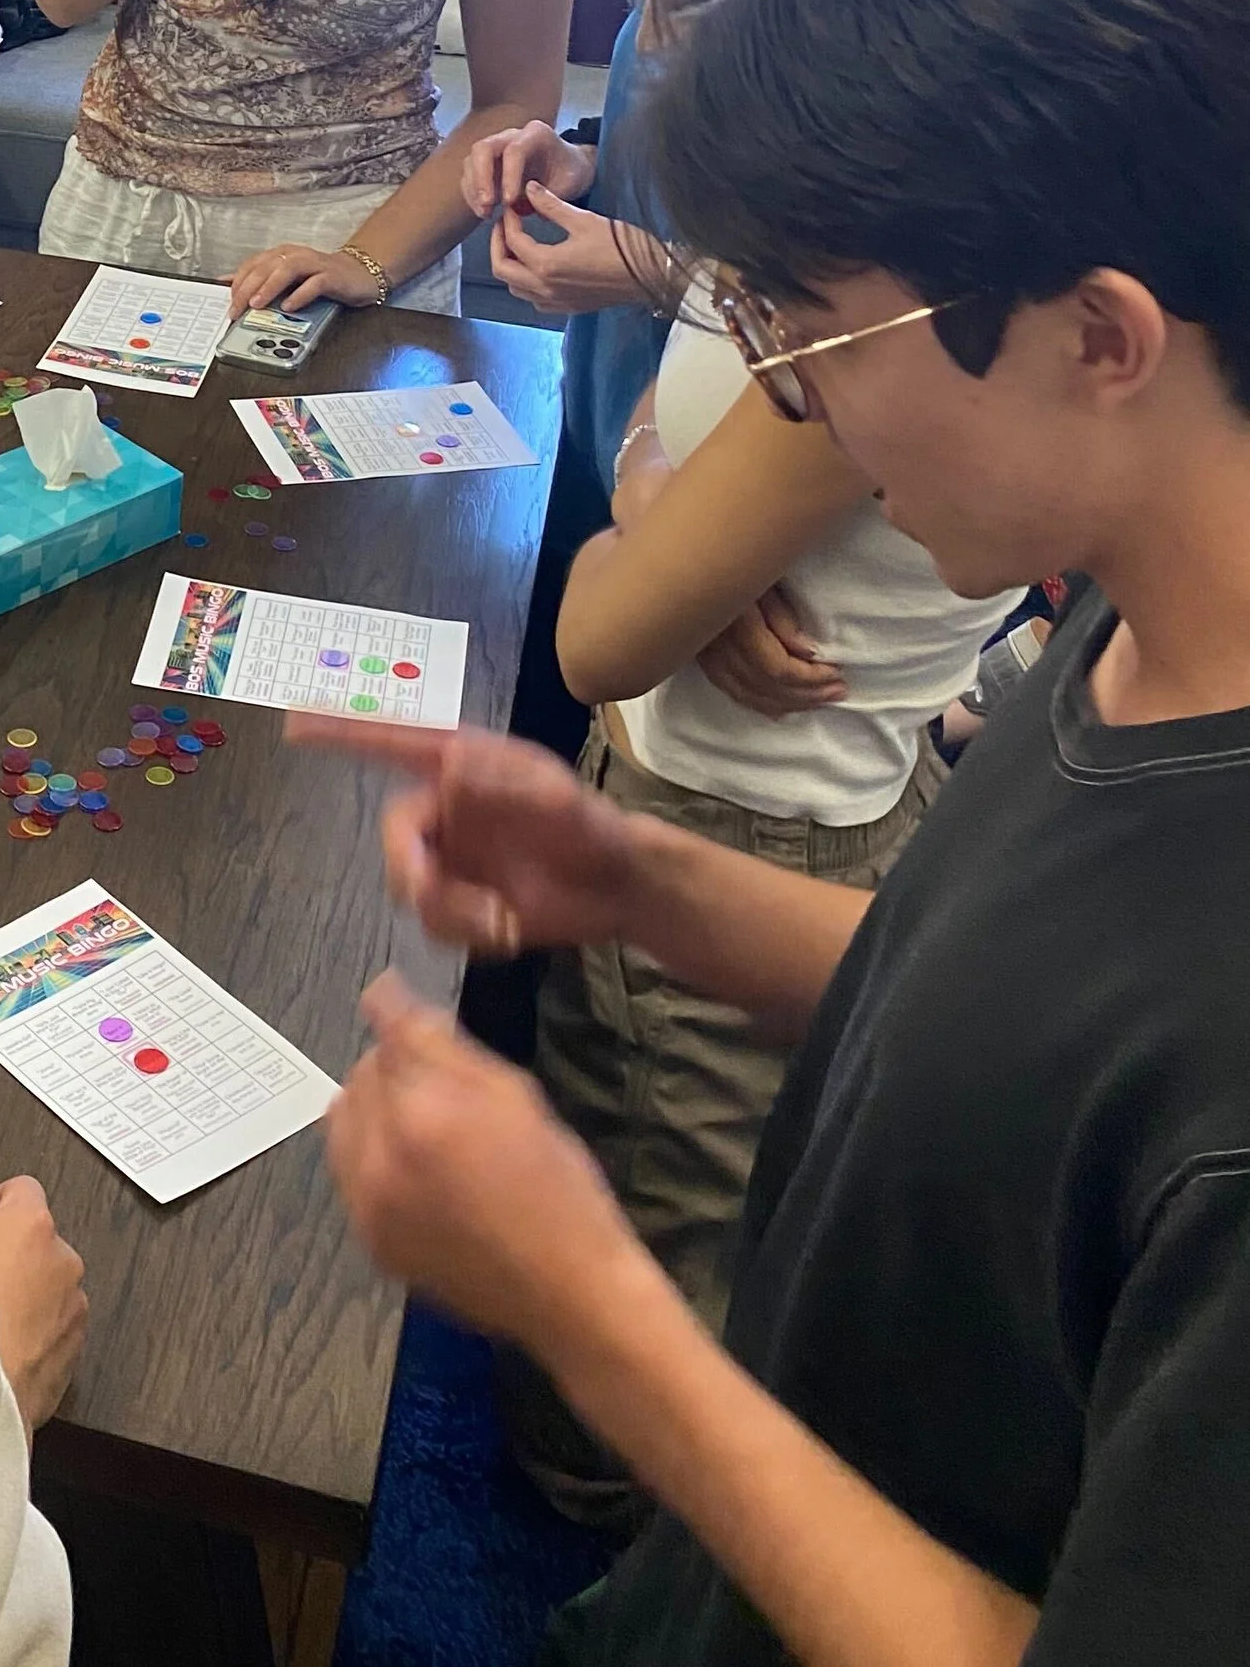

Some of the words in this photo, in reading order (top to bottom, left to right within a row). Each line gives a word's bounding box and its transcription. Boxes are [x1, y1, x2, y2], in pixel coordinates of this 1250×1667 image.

[273, 399, 301, 427] BINGO
[292, 428, 321, 456] MUSIC
[202, 587, 225, 624] BINGO
[191, 624, 215, 663] MUSIC
[184, 665, 204, 690] 80S
[65, 916, 133, 958] BINGO
